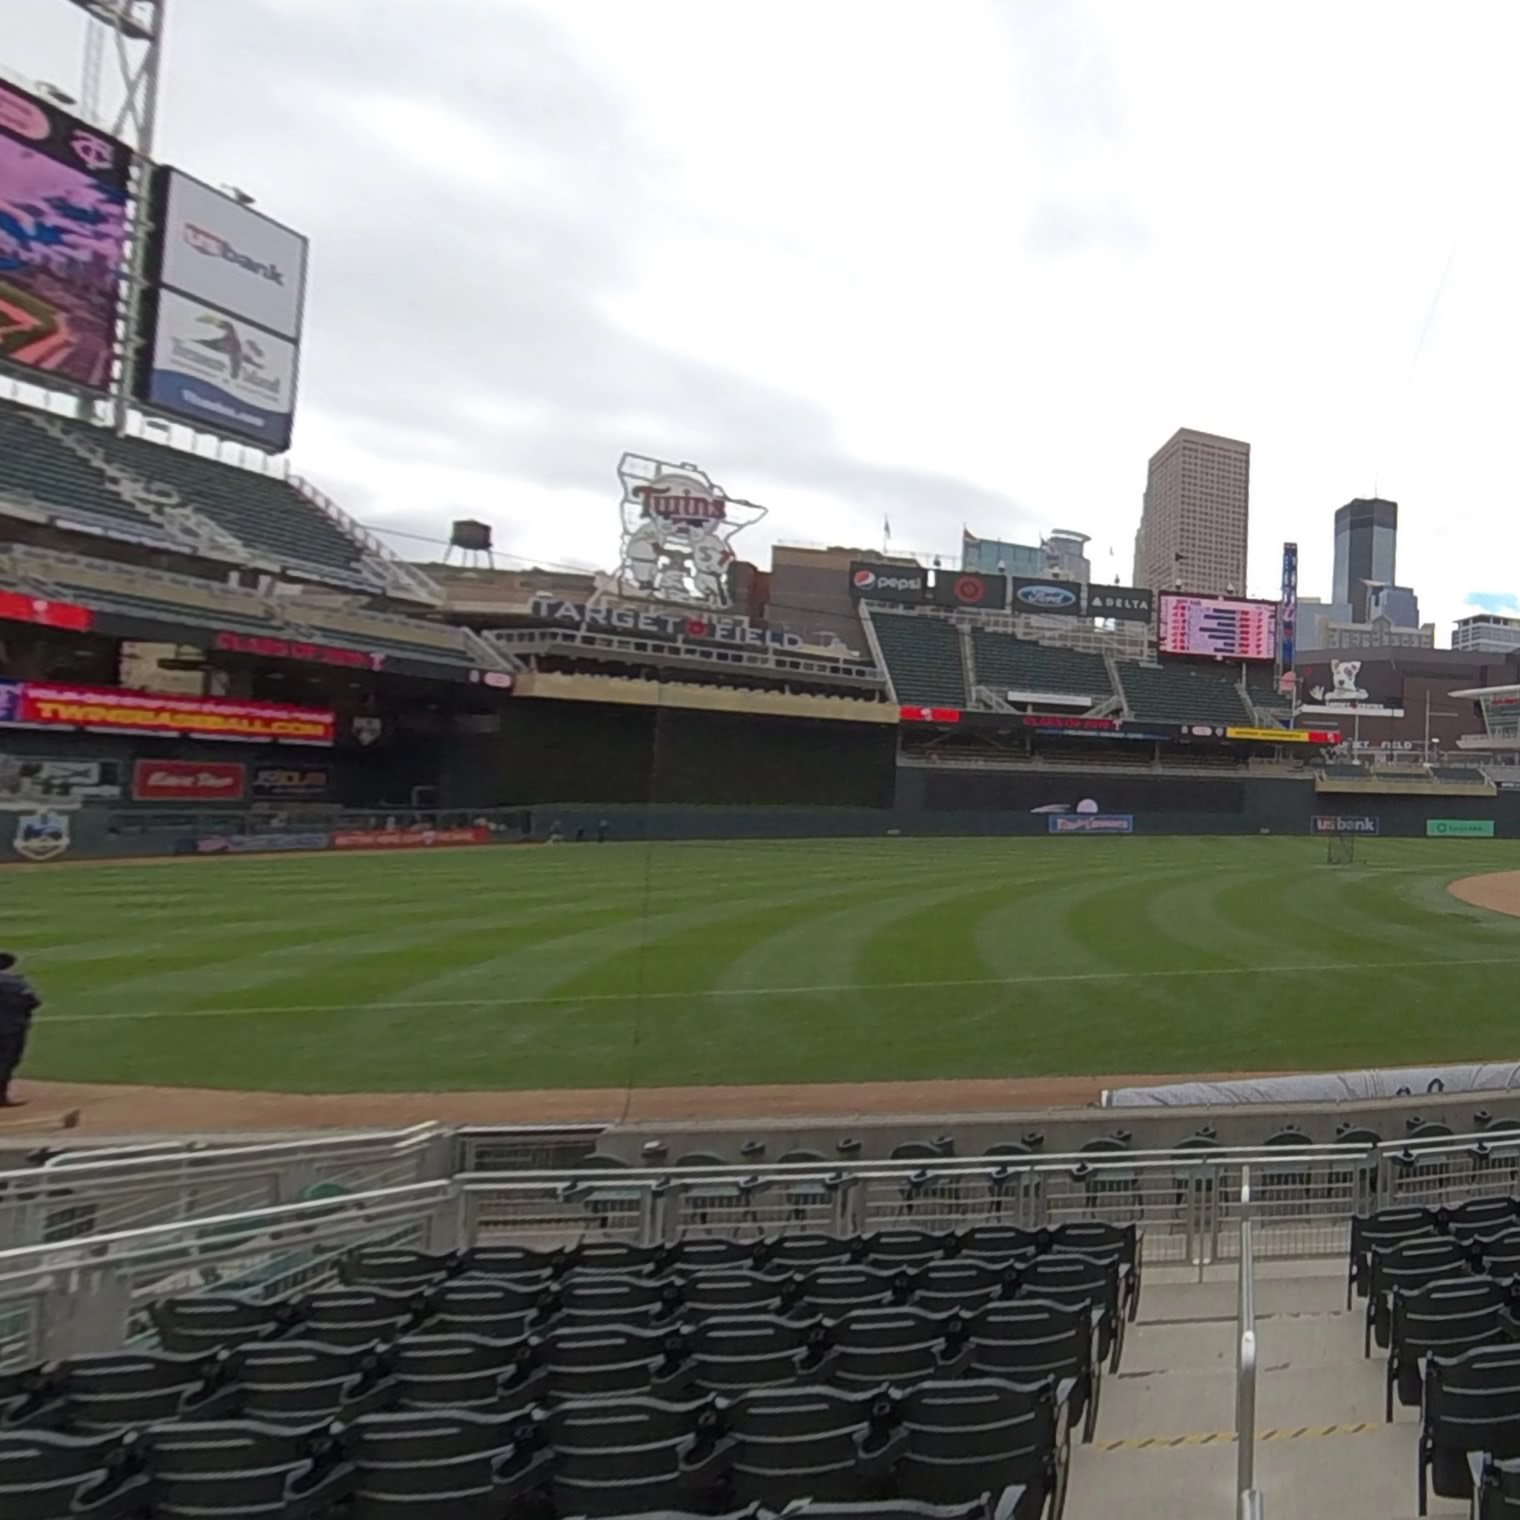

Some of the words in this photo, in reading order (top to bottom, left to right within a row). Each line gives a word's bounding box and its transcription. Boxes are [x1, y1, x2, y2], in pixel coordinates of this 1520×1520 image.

[632, 485, 727, 520] Twins
[877, 576, 922, 591] pepsi
[1026, 586, 1066, 607] Ford
[1106, 596, 1149, 610] DELTA
[537, 599, 681, 634] TARGET
[714, 624, 804, 649] FIELD
